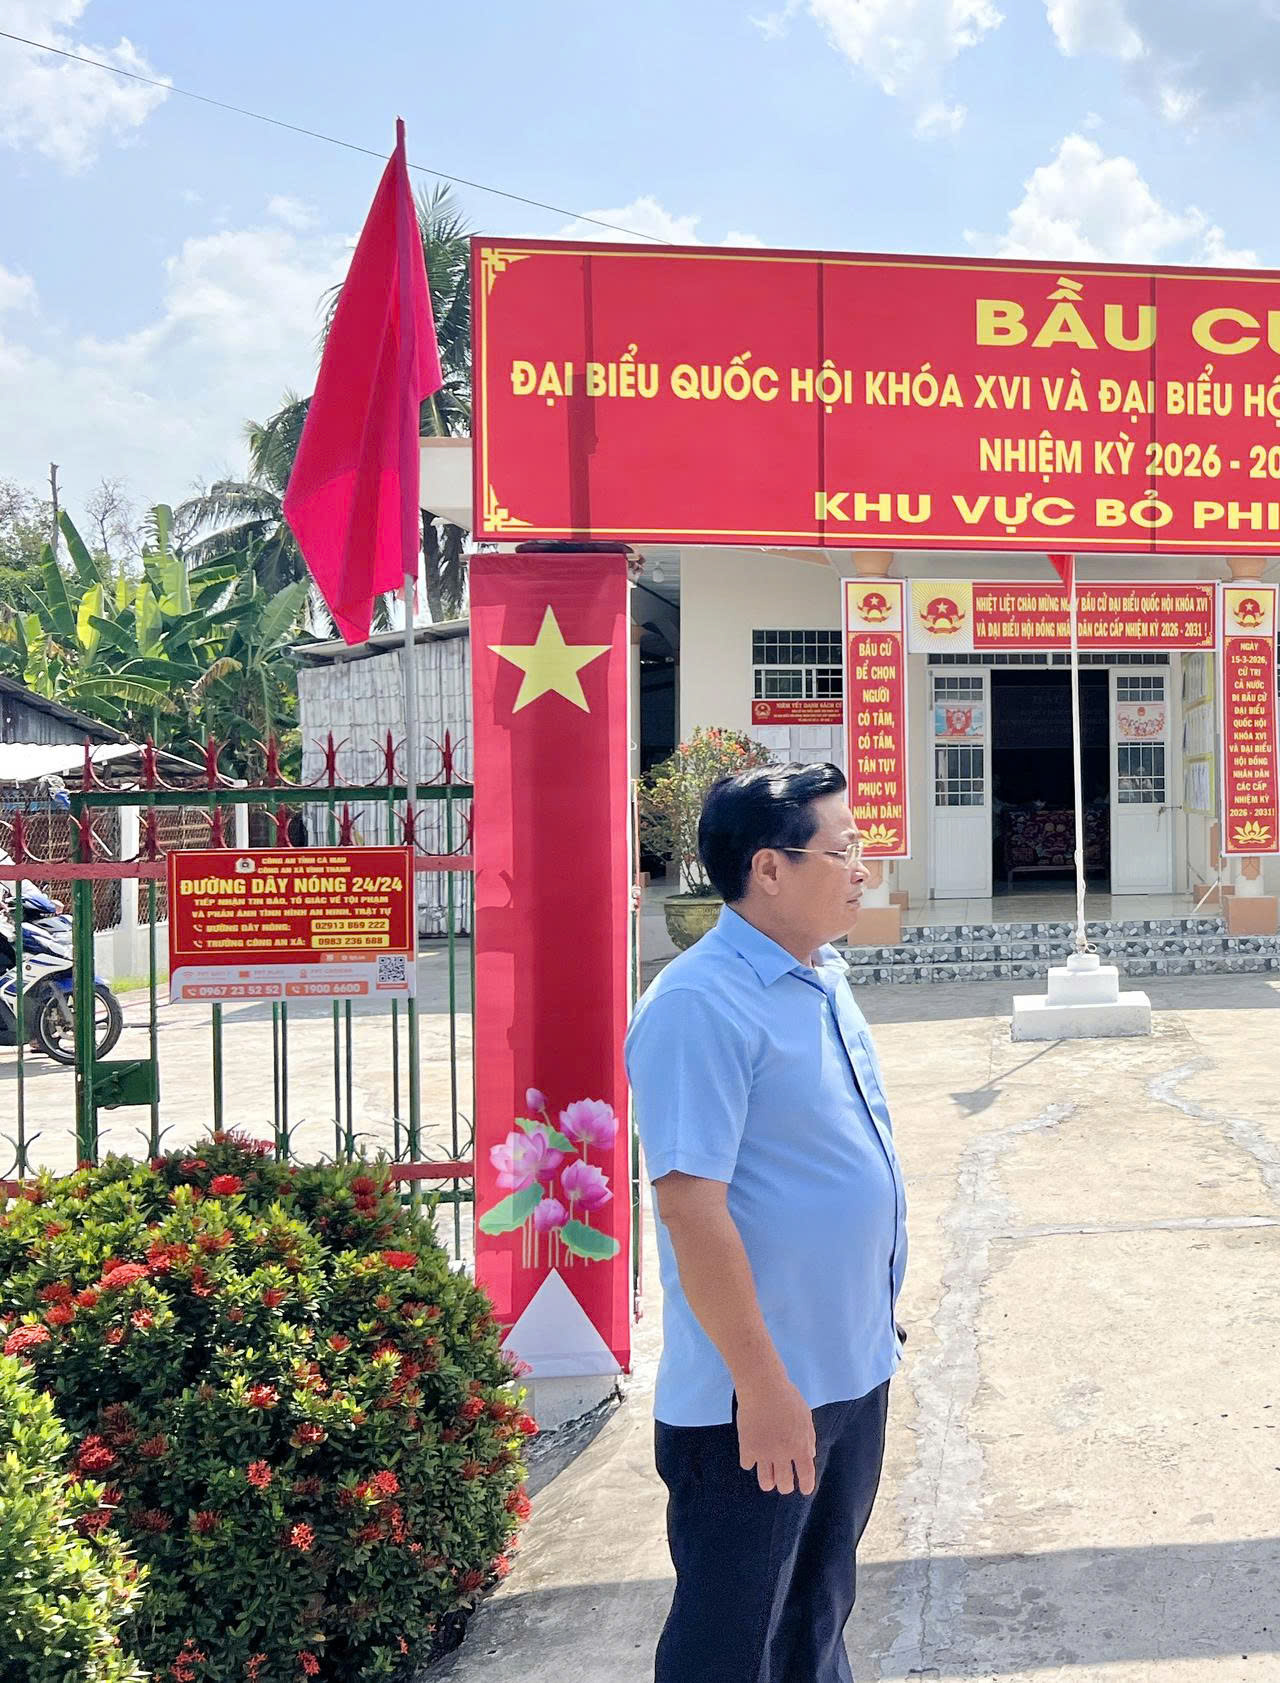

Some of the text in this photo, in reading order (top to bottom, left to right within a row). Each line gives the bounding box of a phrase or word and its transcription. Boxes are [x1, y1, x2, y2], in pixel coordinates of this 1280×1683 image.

[976, 276, 1156, 351] BẦU
[511, 360, 573, 406] ĐẠI
[586, 343, 659, 398] BIỂU
[670, 351, 779, 401] QUỐC
[790, 359, 852, 413] HỘI
[865, 362, 964, 408] KHÓA
[974, 375, 1030, 410] XVI
[1041, 367, 1088, 412] VÀ
[1098, 379, 1154, 423] ĐẠI
[1166, 363, 1233, 416] BIỂU
[979, 430, 1082, 483] NHIỆM
[1094, 431, 1135, 476] KỲ
[1145, 442, 1222, 478] 2026
[1230, 460, 1240, 469] -
[814, 491, 931, 523] KHU
[951, 492, 1075, 534] VỰC
[1095, 489, 1173, 529] BỎ
[976, 593, 997, 614] NHIỆT
[1000, 593, 1015, 614] LIỆT
[1017, 593, 1036, 611] CHÀO
[1038, 593, 1059, 611] MỪNG
[1081, 591, 1096, 611] BẦU
[1097, 591, 1108, 611] CỬ
[1109, 597, 1120, 614] ĐẠI
[1123, 590, 1139, 611] BIỂU
[1141, 592, 1160, 614] QUỐC
[1161, 593, 1173, 614] HỘI
[1175, 593, 1195, 611] KHÓA
[1196, 597, 1208, 611] XVI
[976, 618, 986, 637] VÀ
[988, 622, 1000, 640] ĐẠI
[1002, 615, 1019, 637] BIỂU
[1021, 618, 1034, 640] HỘI
[1035, 616, 1055, 637] ĐỒNG
[1078, 618, 1093, 637] DÂN
[1094, 618, 1108, 637] CÁC
[1110, 617, 1124, 637] CẤP
[1125, 618, 1148, 639] NHIỆM
[1150, 618, 1159, 637] KỲ
[1161, 622, 1178, 637] 2026
[1185, 622, 1202, 637] 2031
[859, 638, 892, 656] BẦU CỬ
[856, 659, 896, 682] ĐỂ CHỌN
[863, 686, 889, 702] NGƯỜI
[858, 709, 895, 728] CÓ TÂM,
[858, 733, 870, 749] CÓ
[858, 755, 896, 775] TẬN TỤY
[858, 782, 896, 798] PHỤC VỤ
[853, 802, 902, 819] NHÂN DÂN!
[180, 875, 402, 895] ĐƯỜNG DÂY NÓNG 24/24
[200, 986, 279, 995] 0967 23 52 52
[304, 984, 360, 993] 1900 6600
